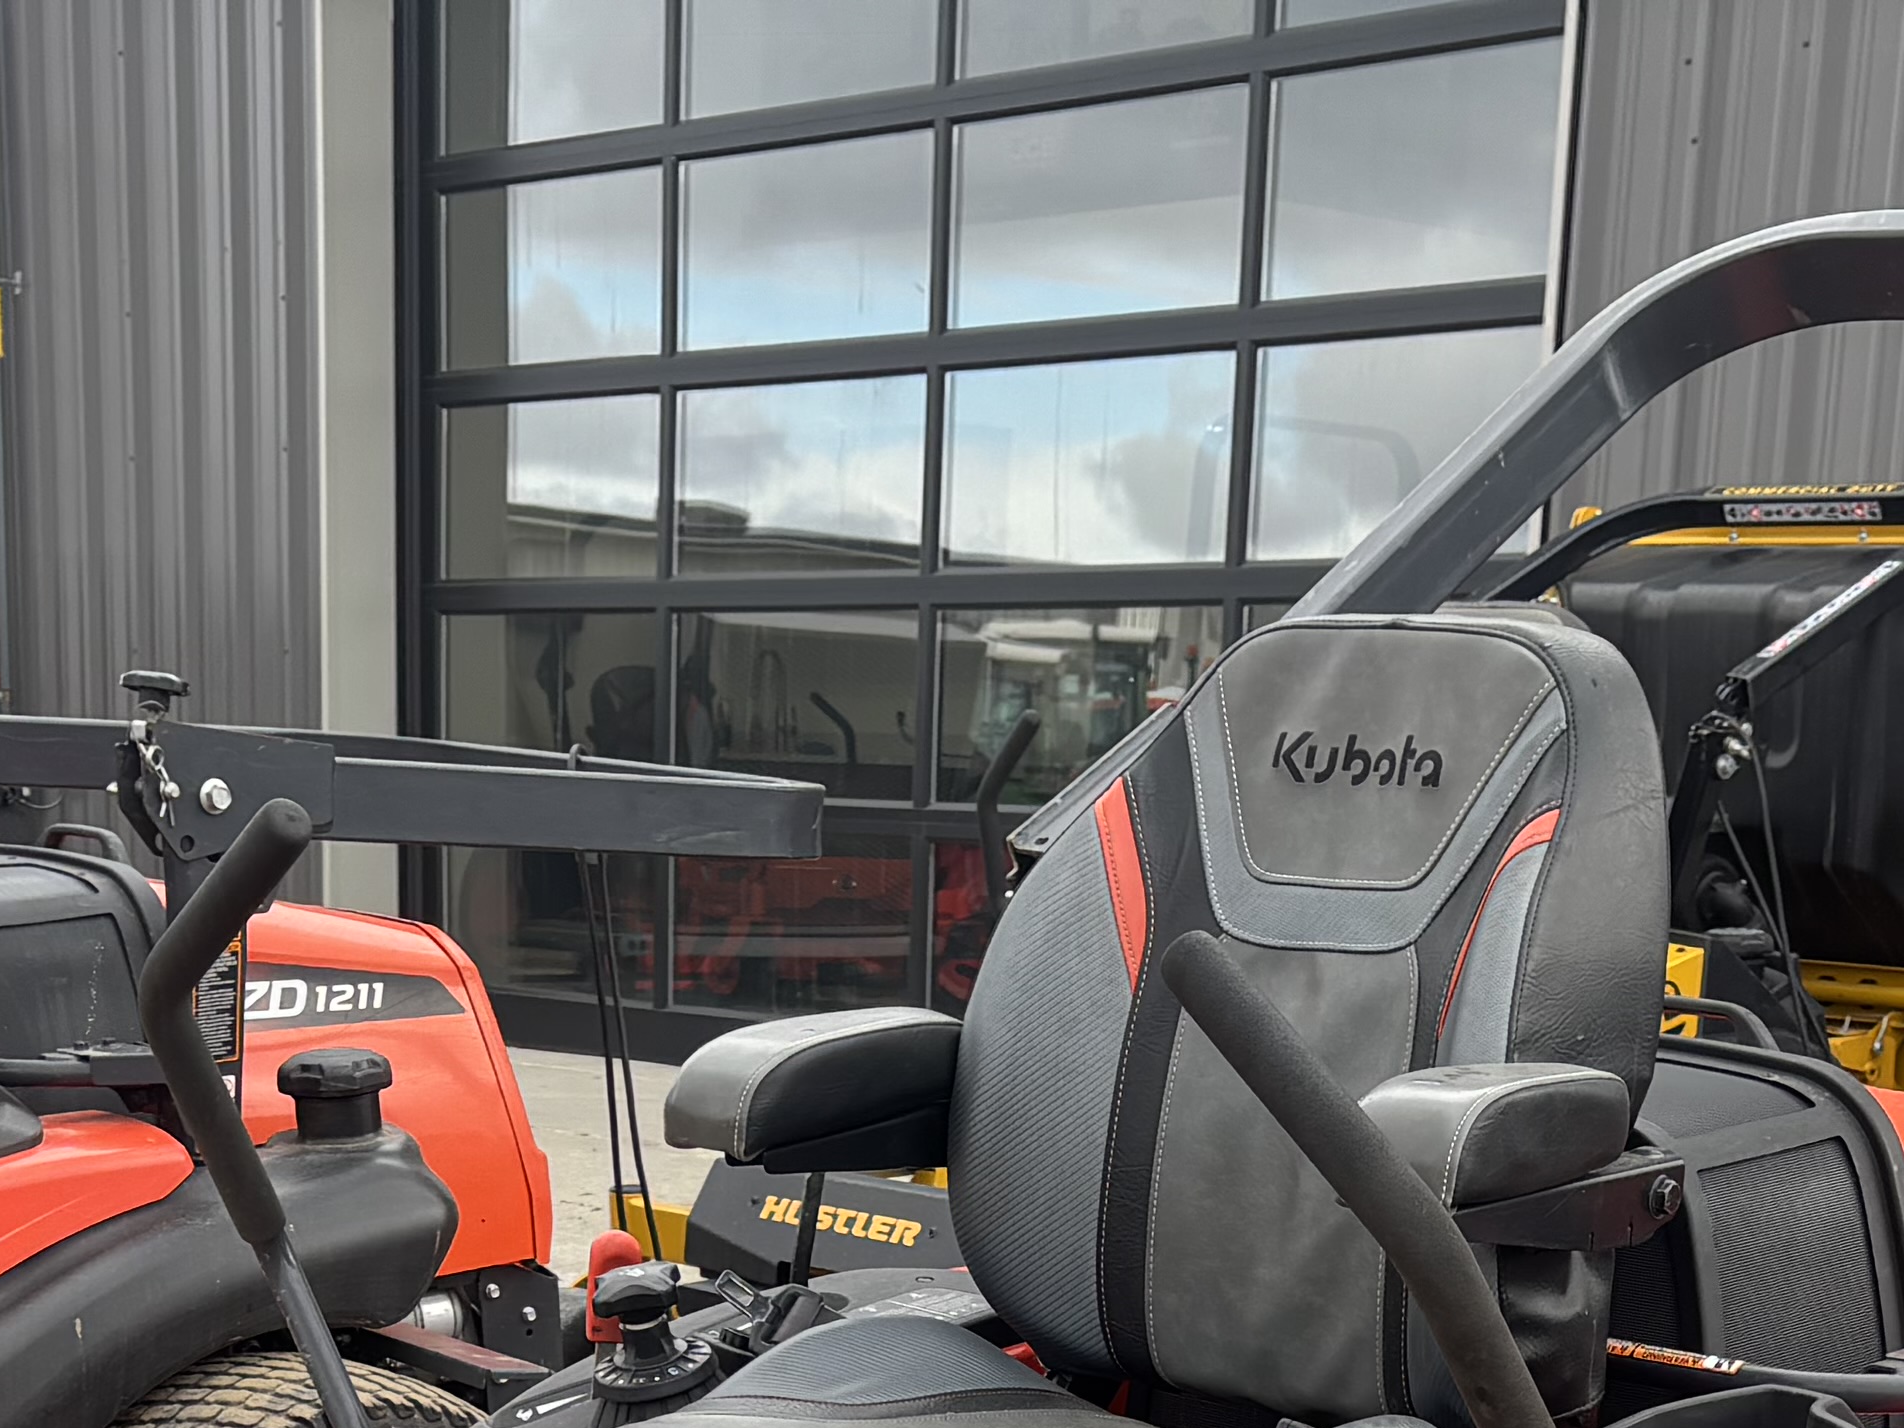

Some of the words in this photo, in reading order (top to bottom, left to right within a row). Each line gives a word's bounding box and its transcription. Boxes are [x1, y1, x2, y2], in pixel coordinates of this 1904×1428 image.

[1272, 730, 1444, 789] Kubota
[244, 979, 306, 1020] ZD
[314, 981, 384, 1014] 1211
